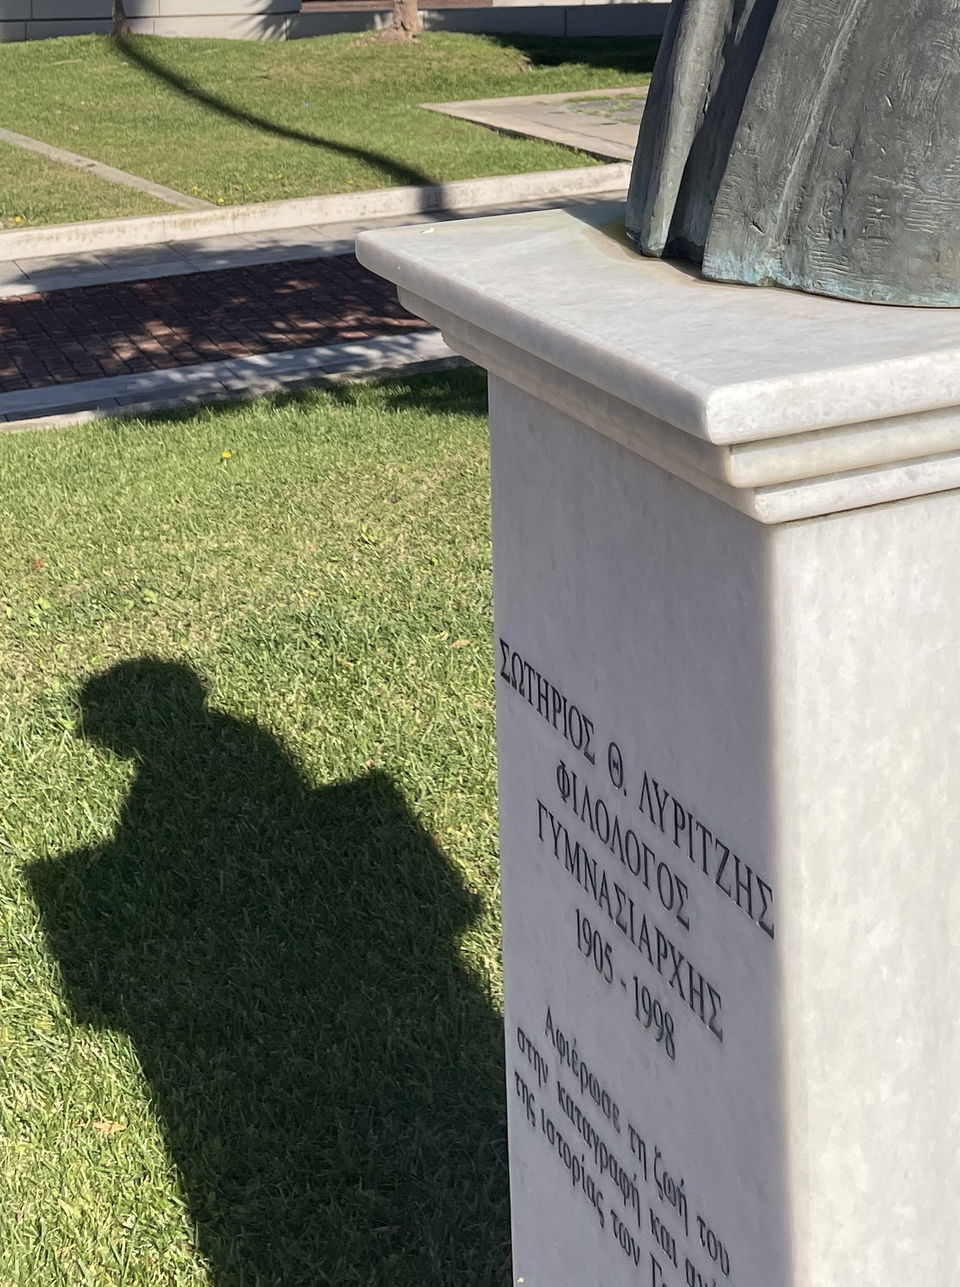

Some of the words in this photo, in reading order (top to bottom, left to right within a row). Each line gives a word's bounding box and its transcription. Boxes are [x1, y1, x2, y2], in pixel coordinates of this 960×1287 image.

[499, 638, 596, 766] ΣΩΤΗΡΙΟΣ
[639, 771, 775, 940] ΛΥΡΙΤΖΗΣ
[556, 760, 690, 932] ΦΙΛΟΛΟΓΟΣ
[536, 797, 724, 1043] ΓΥΜΝΑΣΙΑΡΧΗΣ
[575, 908, 613, 984] 1905
[633, 975, 676, 1062] 1998
[514, 1070, 536, 1128] της
[611, 1208, 640, 1267] των
[517, 1026, 548, 1088] στην
[557, 1080, 640, 1227] καταγραφή
[649, 1208, 678, 1269] και
[544, 1005, 621, 1135] Αφιέρωσε
[627, 1122, 647, 1181] τη
[654, 1145, 688, 1237] ζωή
[697, 1215, 730, 1277] του
